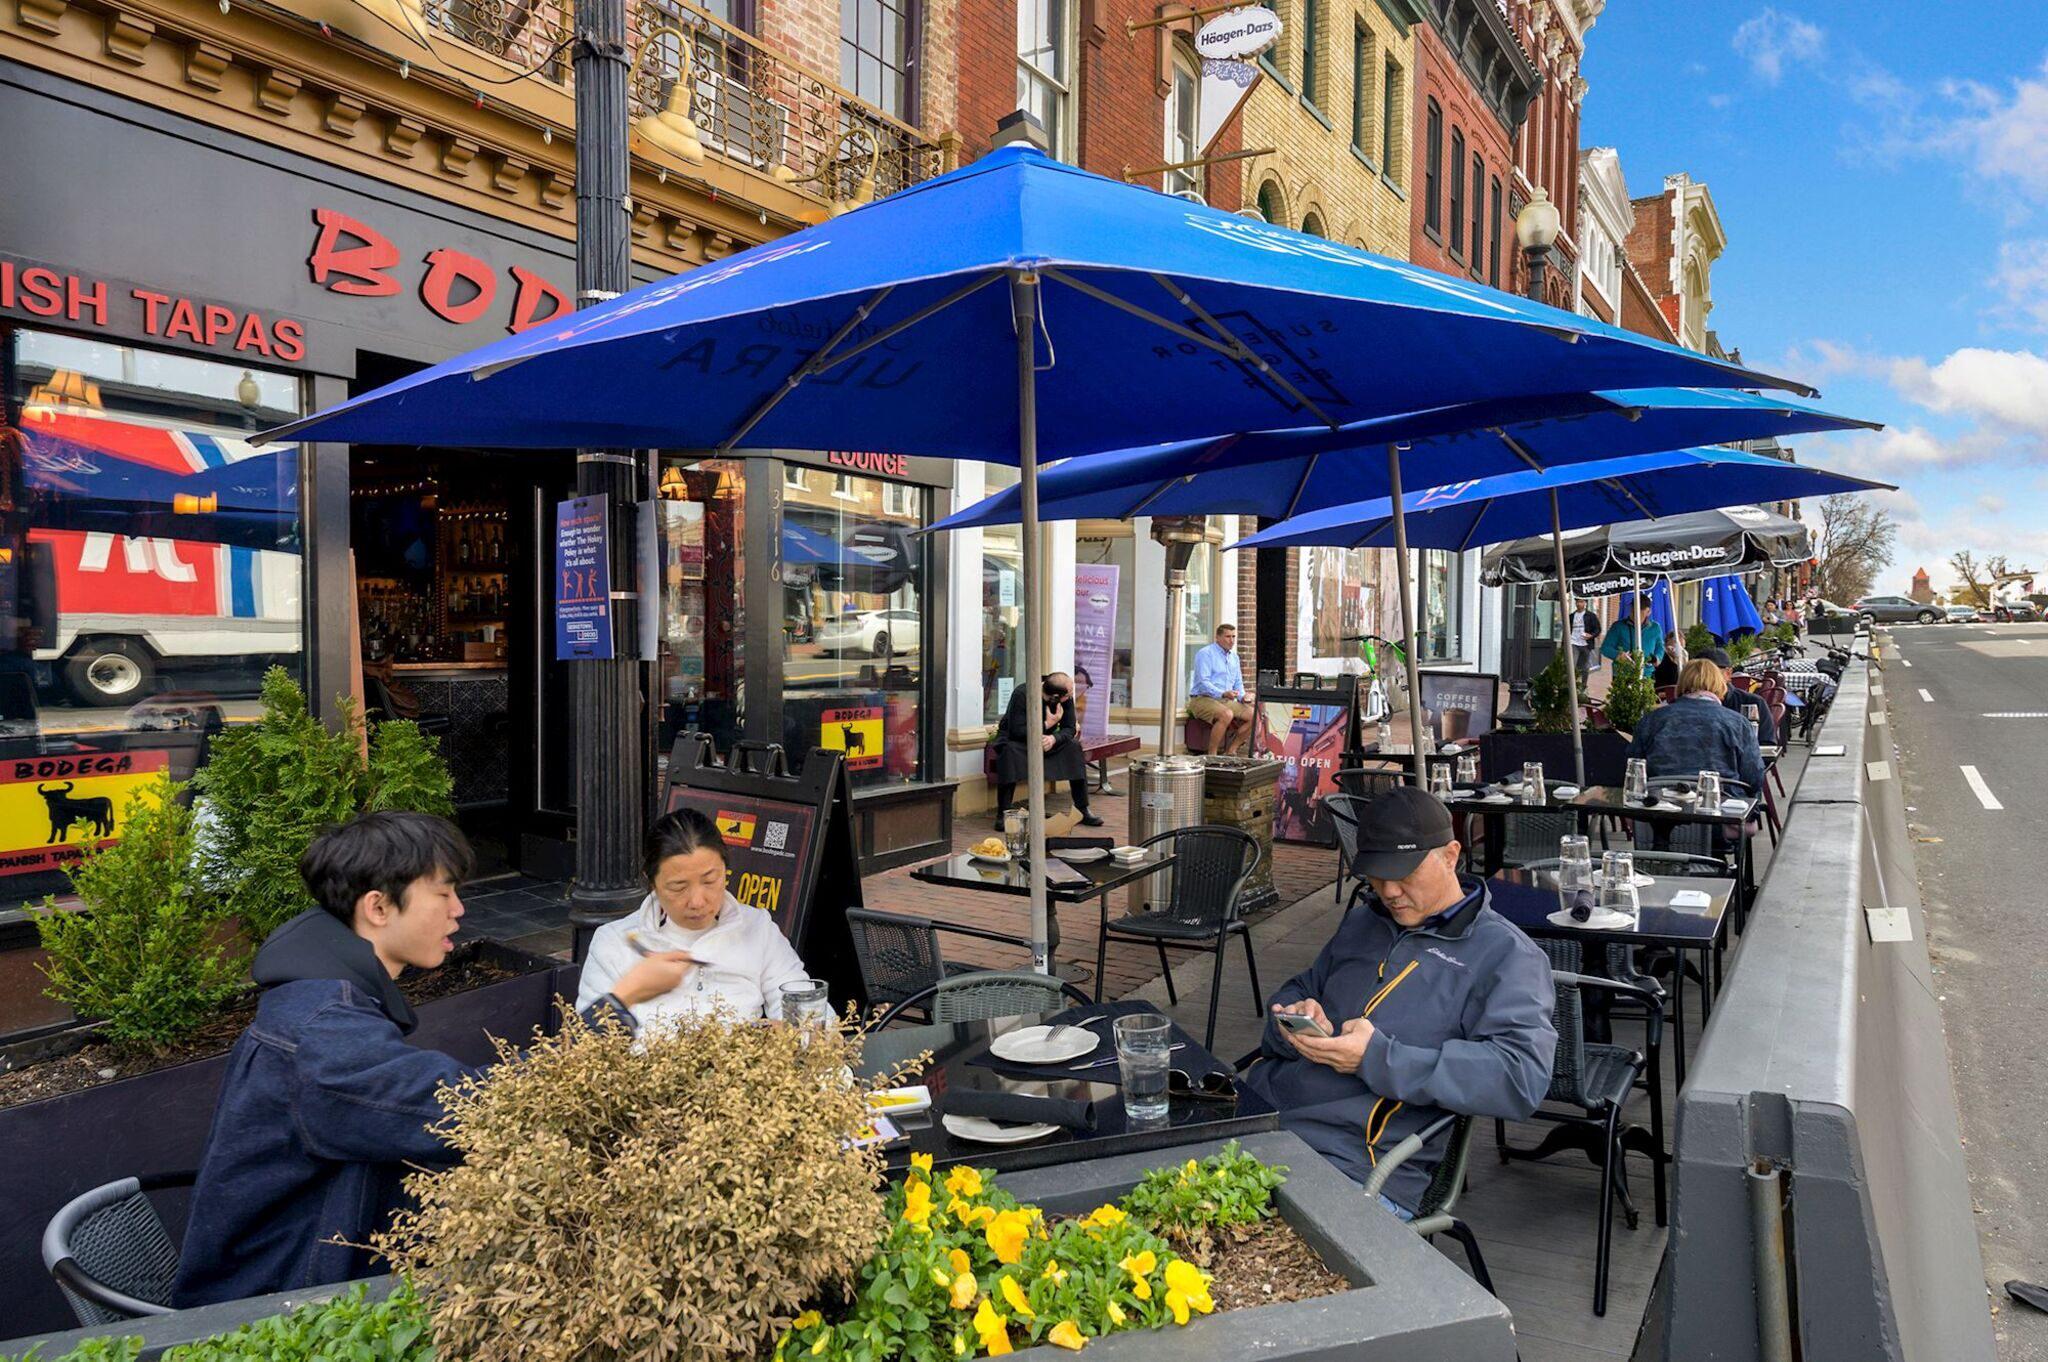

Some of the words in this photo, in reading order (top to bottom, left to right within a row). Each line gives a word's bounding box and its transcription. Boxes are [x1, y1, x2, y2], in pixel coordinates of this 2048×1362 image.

[1201, 21, 1273, 46] Häagen-Dazs
[131, 287, 306, 363] TAPAS
[828, 451, 909, 476] LOUNGE
[583, 524, 601, 533] wonder
[559, 538, 577, 547] whether
[577, 536, 586, 545] The
[583, 546, 597, 554] what
[1629, 545, 1727, 566] Häagen-Dazs
[1582, 576, 1648, 594] Häagen-Das
[1436, 693, 1478, 703] COFFEE
[1436, 701, 1478, 711] FRAPPE
[834, 709, 872, 720] BODEGA
[14, 755, 133, 779] BODEGA
[1300, 757, 1331, 768] OPEN
[737, 872, 782, 911] OPEN
